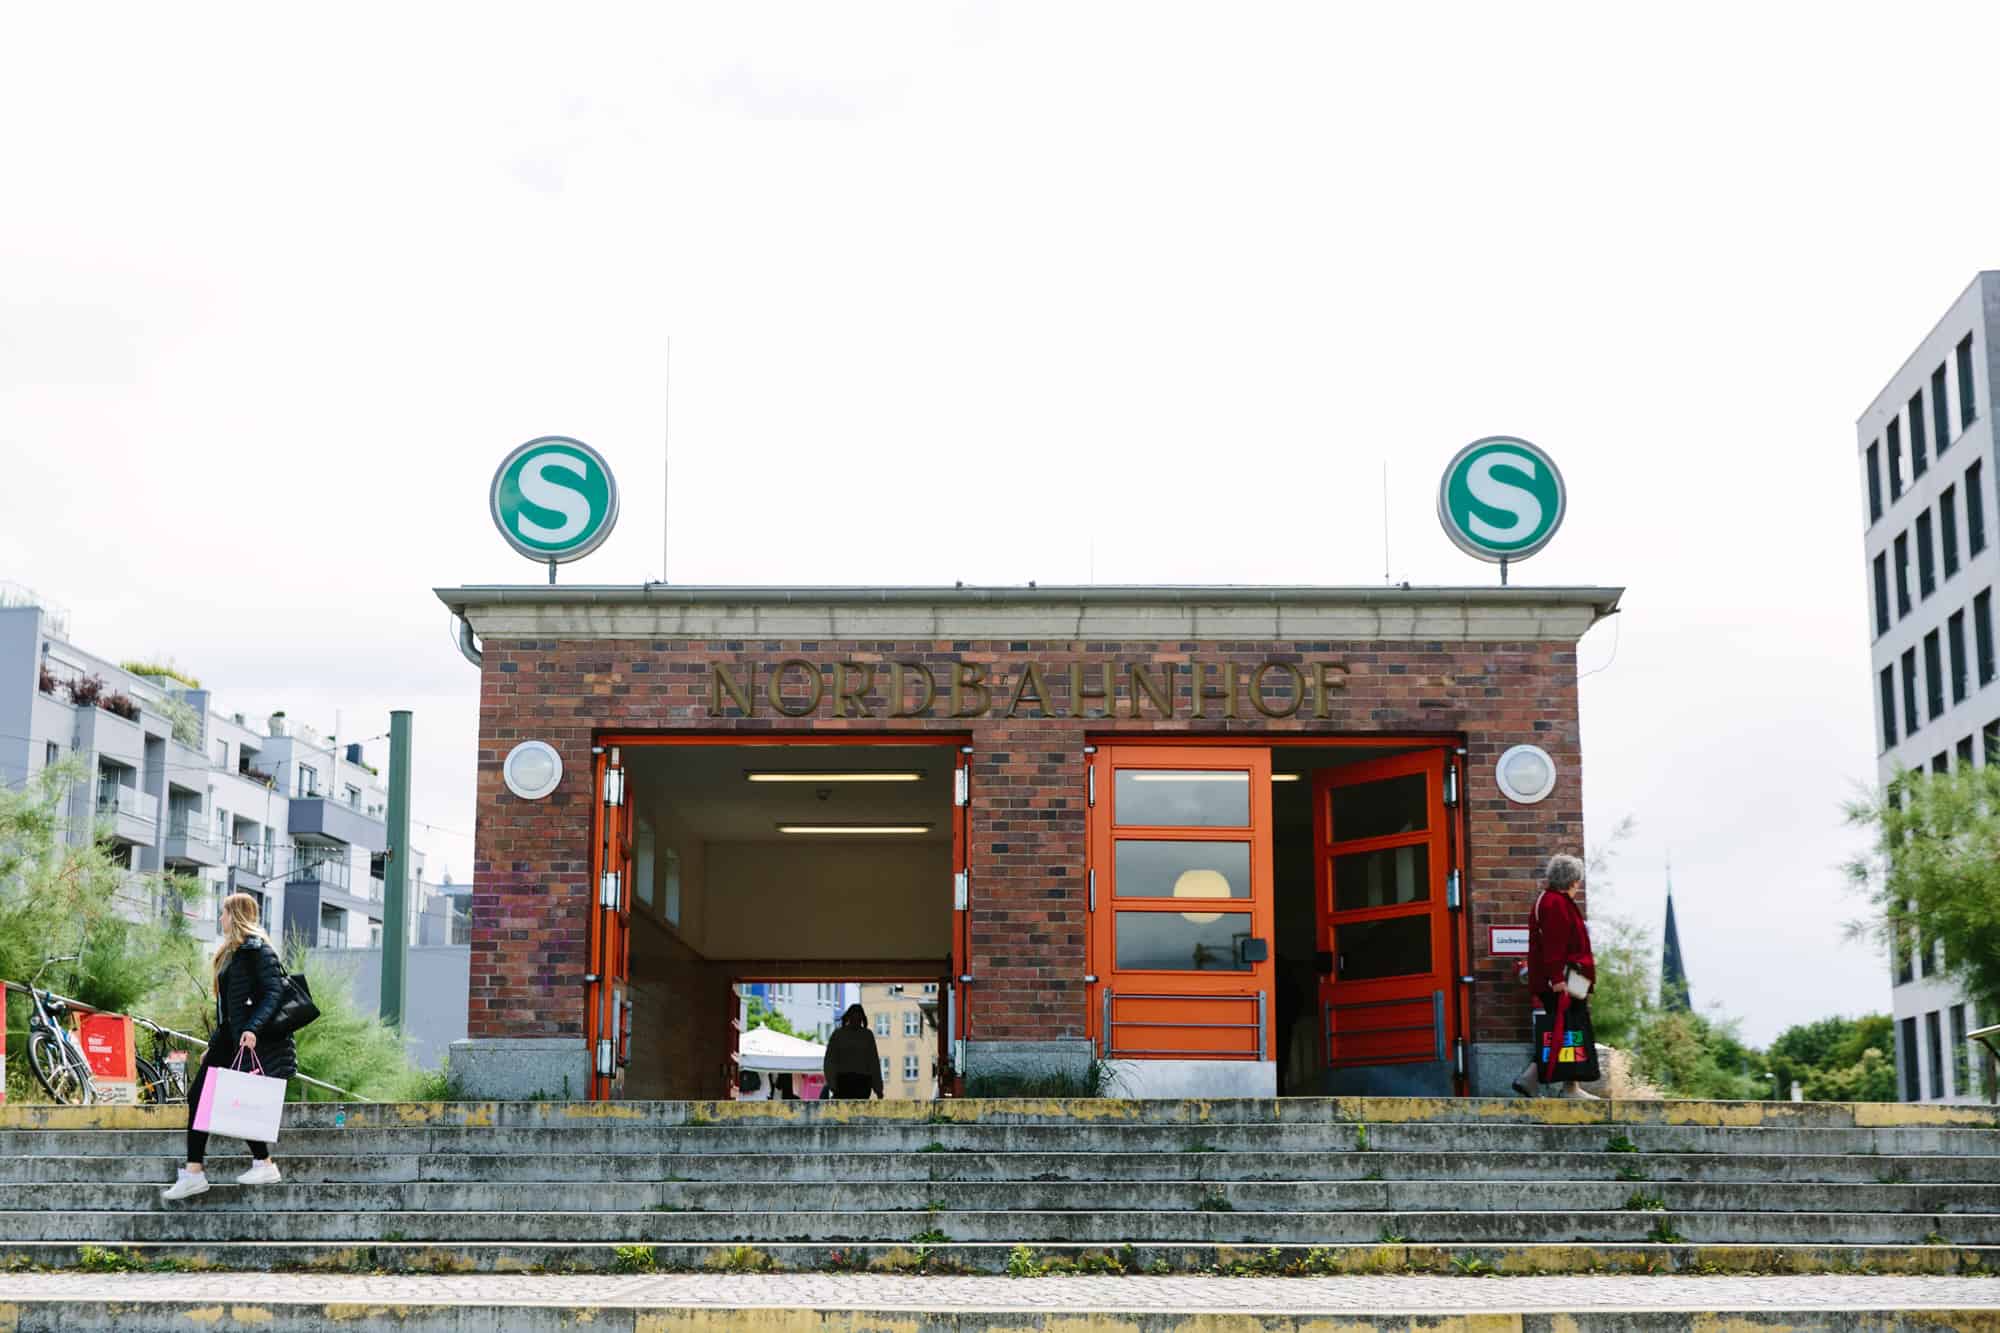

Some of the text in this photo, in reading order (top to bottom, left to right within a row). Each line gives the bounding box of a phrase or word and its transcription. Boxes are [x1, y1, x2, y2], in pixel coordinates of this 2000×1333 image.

[518, 452, 591, 543] S
[1467, 452, 1542, 543] S
[710, 659, 1351, 718] NORDBAHNHOF
